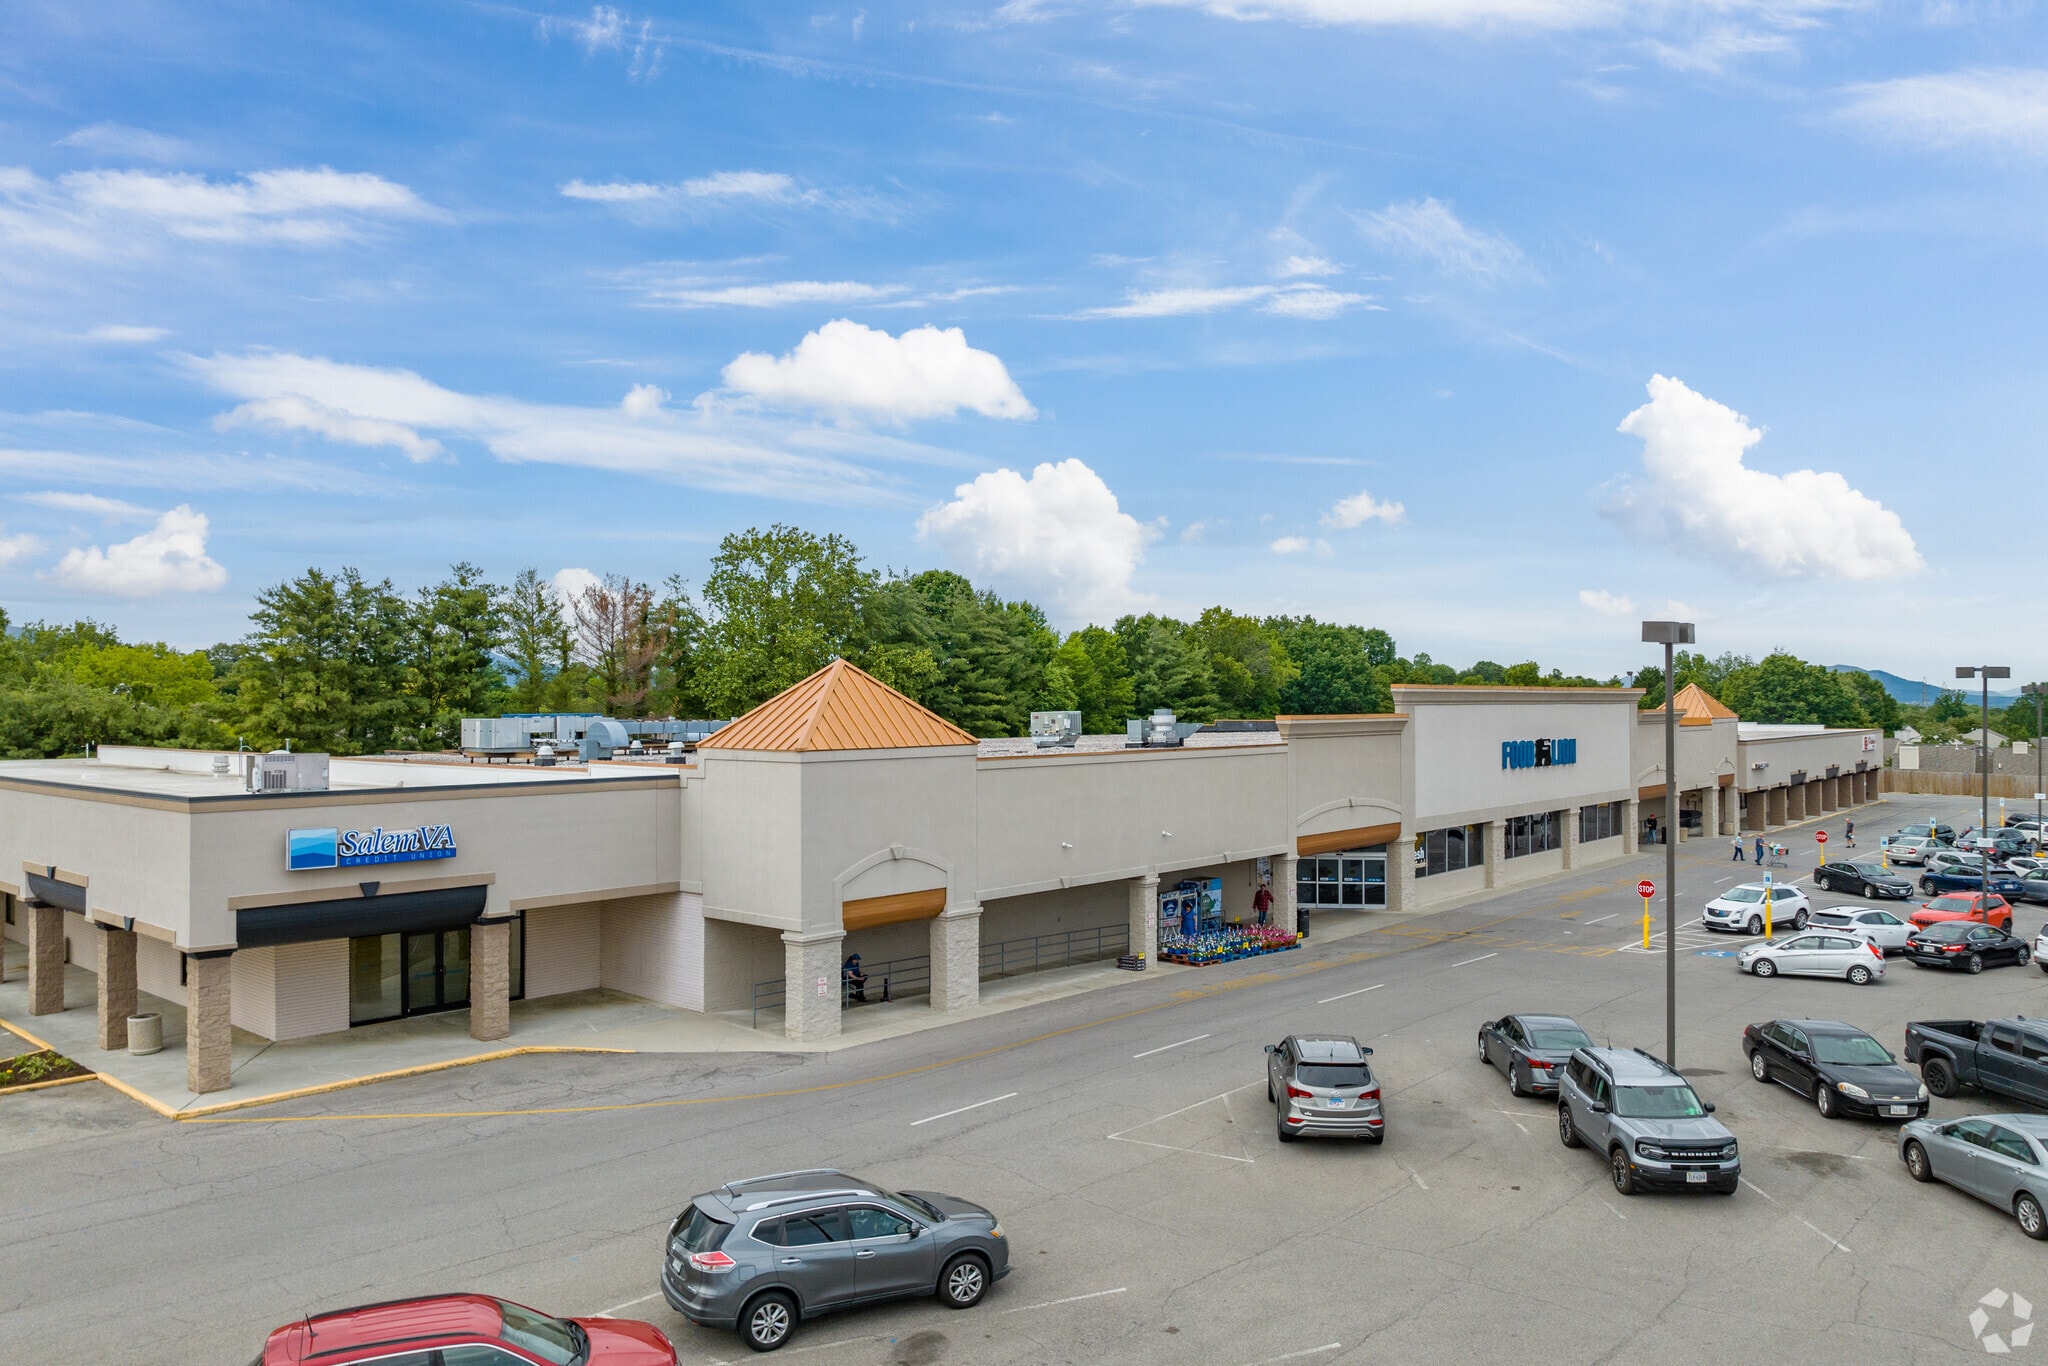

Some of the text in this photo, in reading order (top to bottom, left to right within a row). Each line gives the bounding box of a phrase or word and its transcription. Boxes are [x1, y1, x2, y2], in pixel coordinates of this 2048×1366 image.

[1502, 738, 1577, 770] FOOD LION
[346, 850, 452, 865] CREDIT UNION
[1638, 885, 1654, 893] STOP
